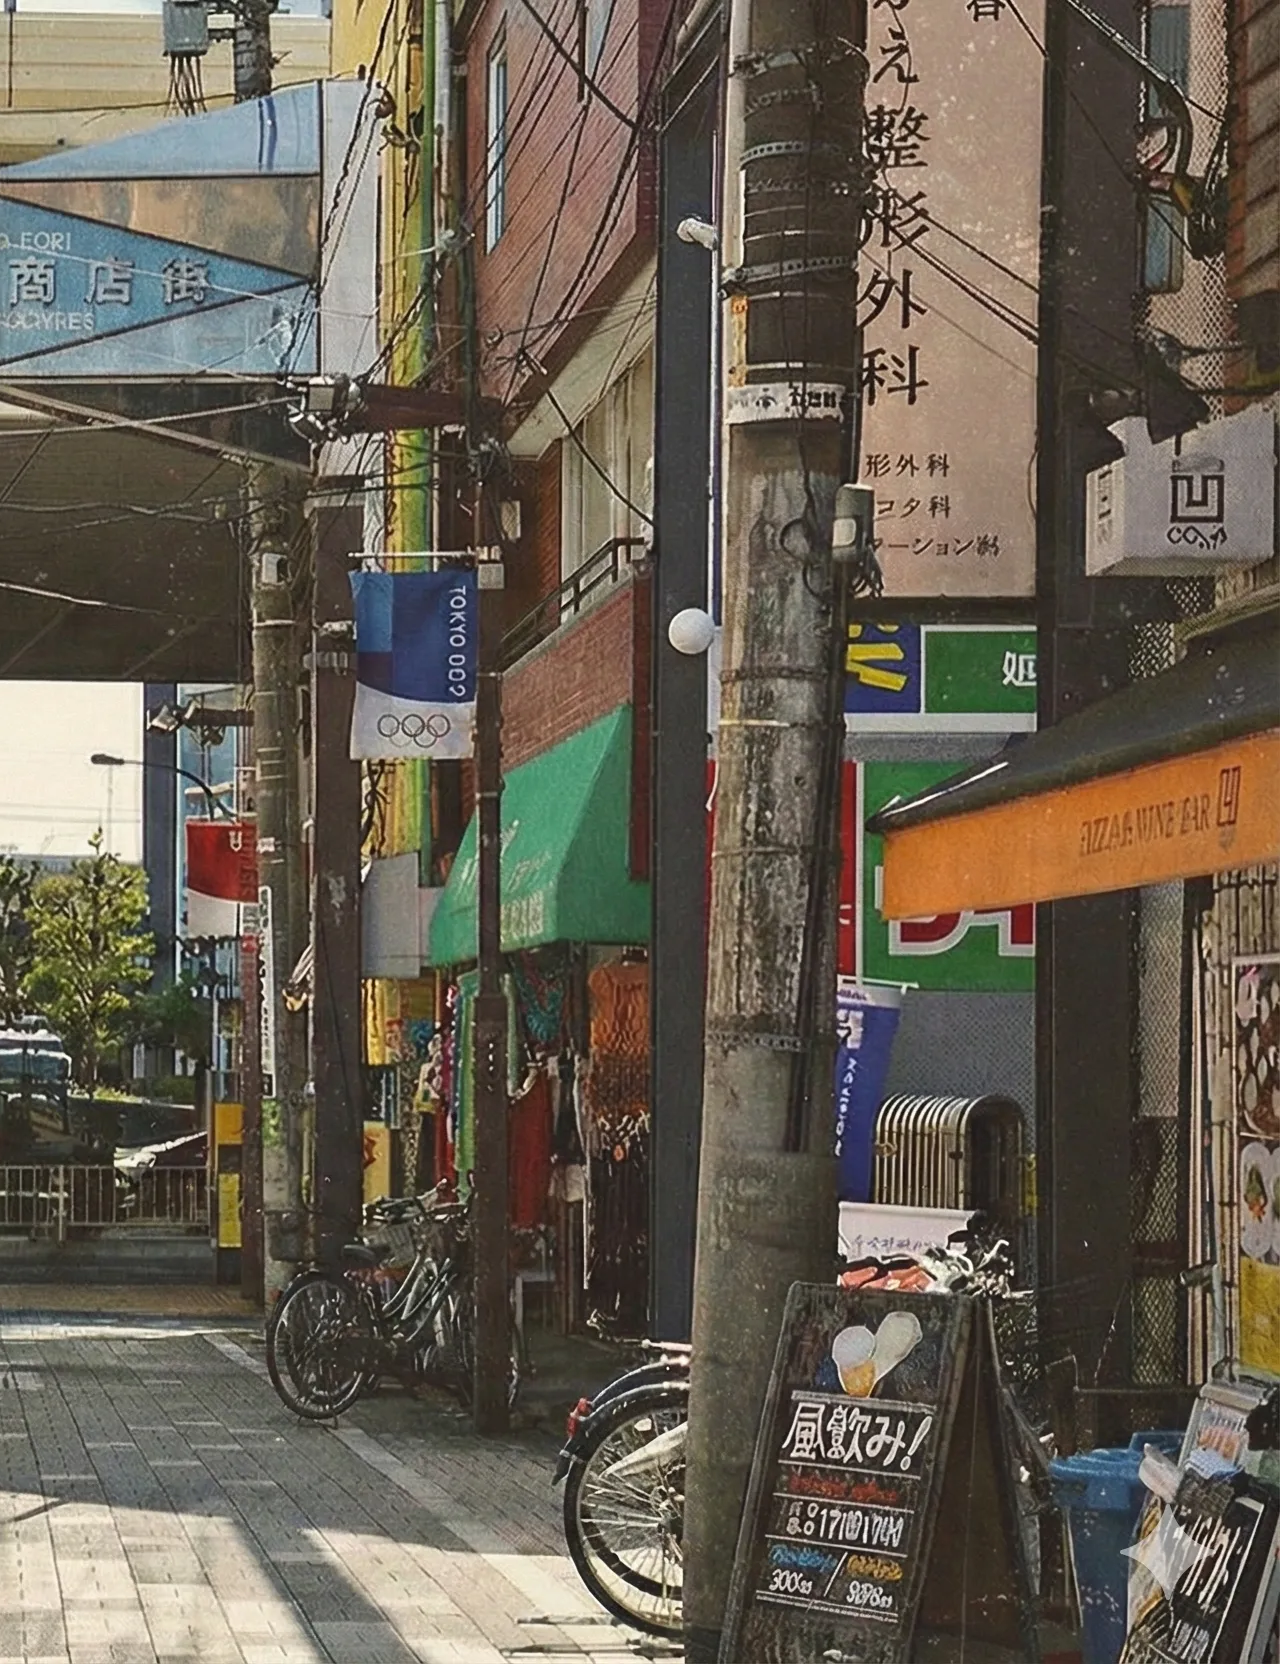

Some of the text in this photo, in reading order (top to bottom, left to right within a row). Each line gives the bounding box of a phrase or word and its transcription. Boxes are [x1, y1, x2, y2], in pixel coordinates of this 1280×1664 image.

[856, 0, 932, 407] え整形外科
[448, 585, 467, 647] TOKYO
